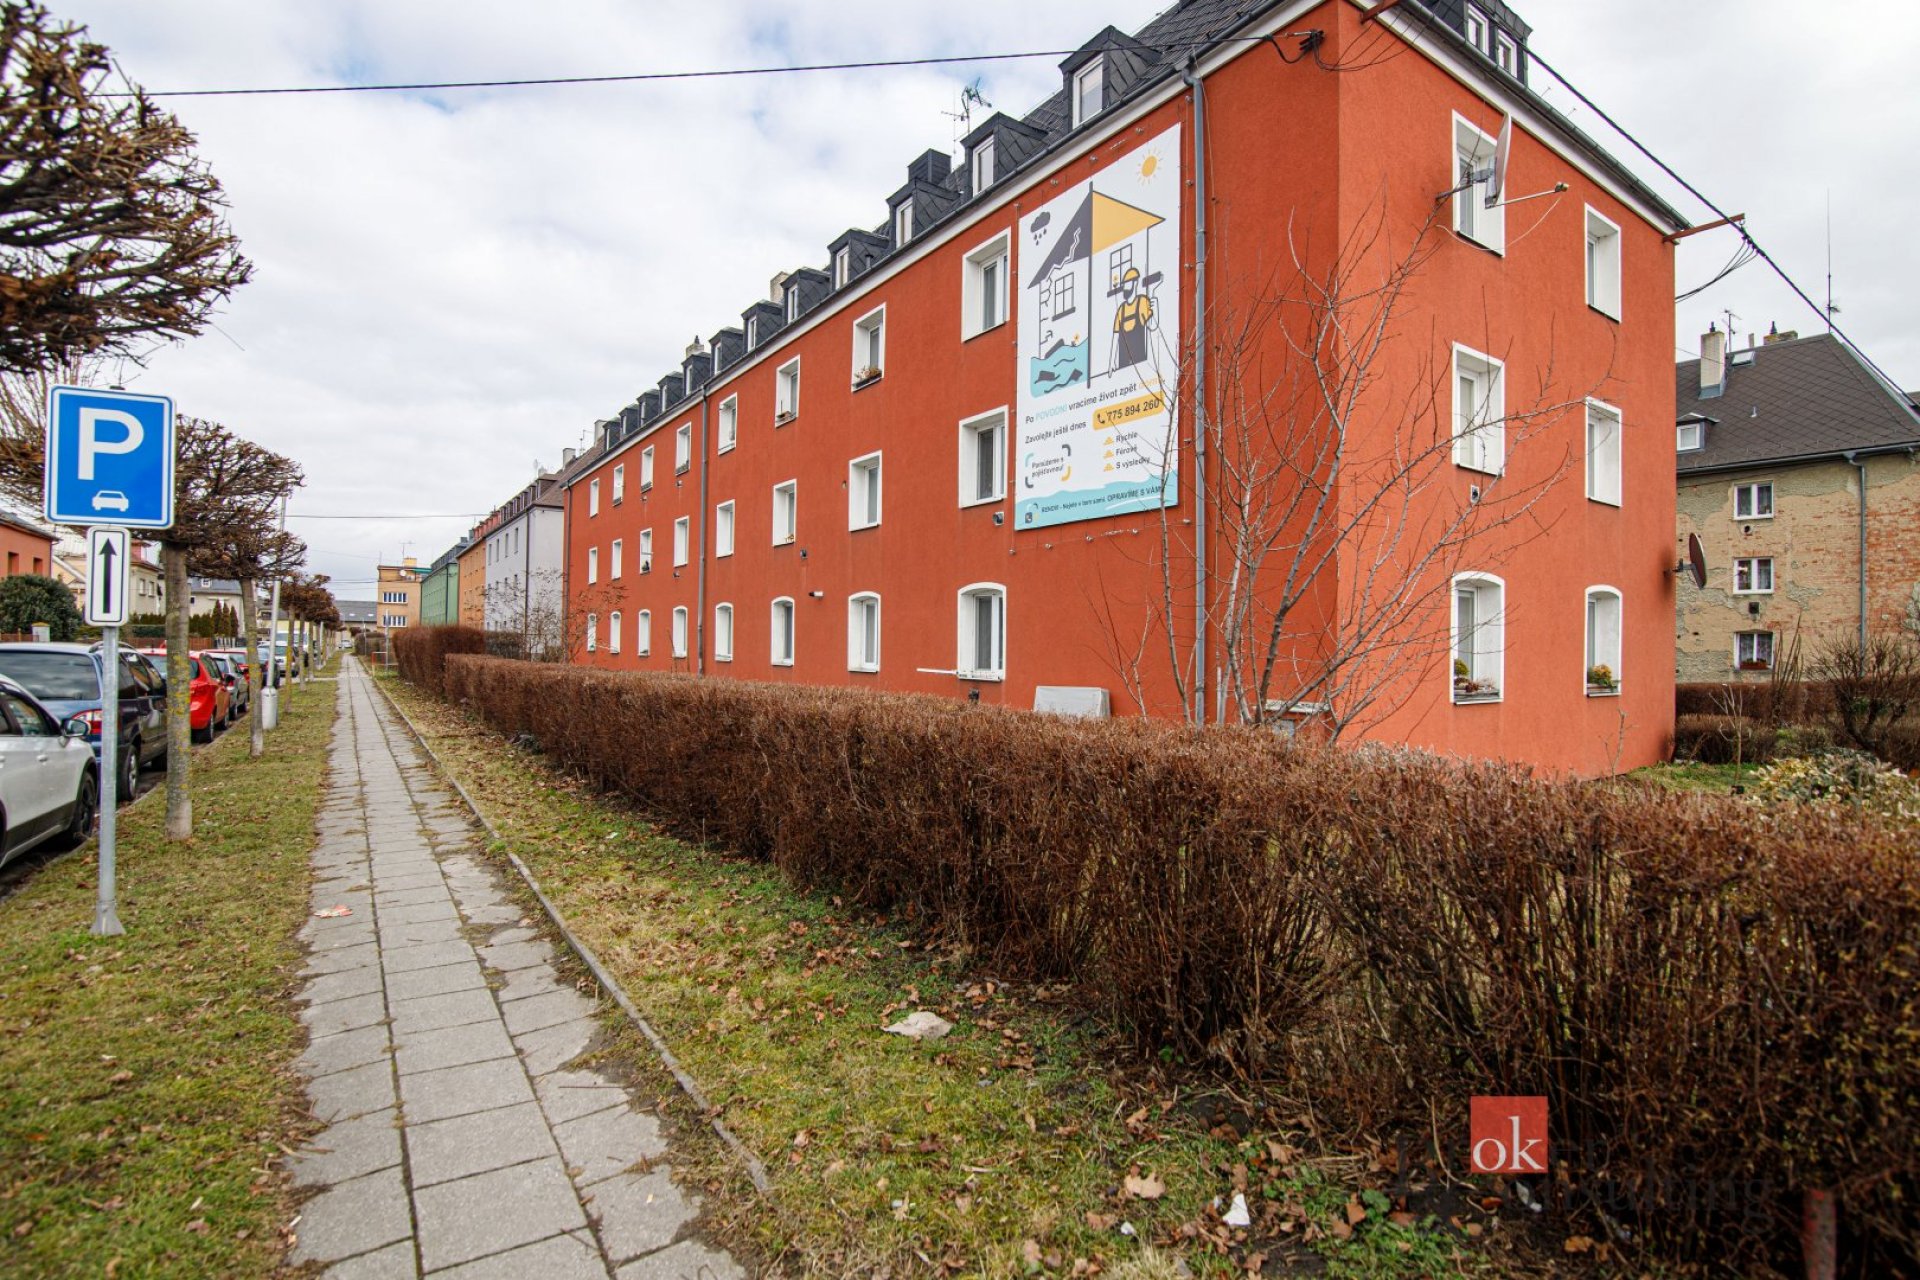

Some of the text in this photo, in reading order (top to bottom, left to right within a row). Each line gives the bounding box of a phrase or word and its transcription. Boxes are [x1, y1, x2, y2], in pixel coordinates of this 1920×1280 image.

[1025, 415, 1034, 424] Po
[1068, 395, 1097, 411] vracíme
[1098, 388, 1117, 402] život
[1119, 383, 1137, 398] zpět
[1107, 398, 1160, 420] 775 894 260
[78, 406, 144, 481] P
[1024, 430, 1052, 444] Zavolejte
[1069, 421, 1087, 431] dnes
[1116, 431, 1138, 443] Rychle
[1116, 461, 1121, 469] S
